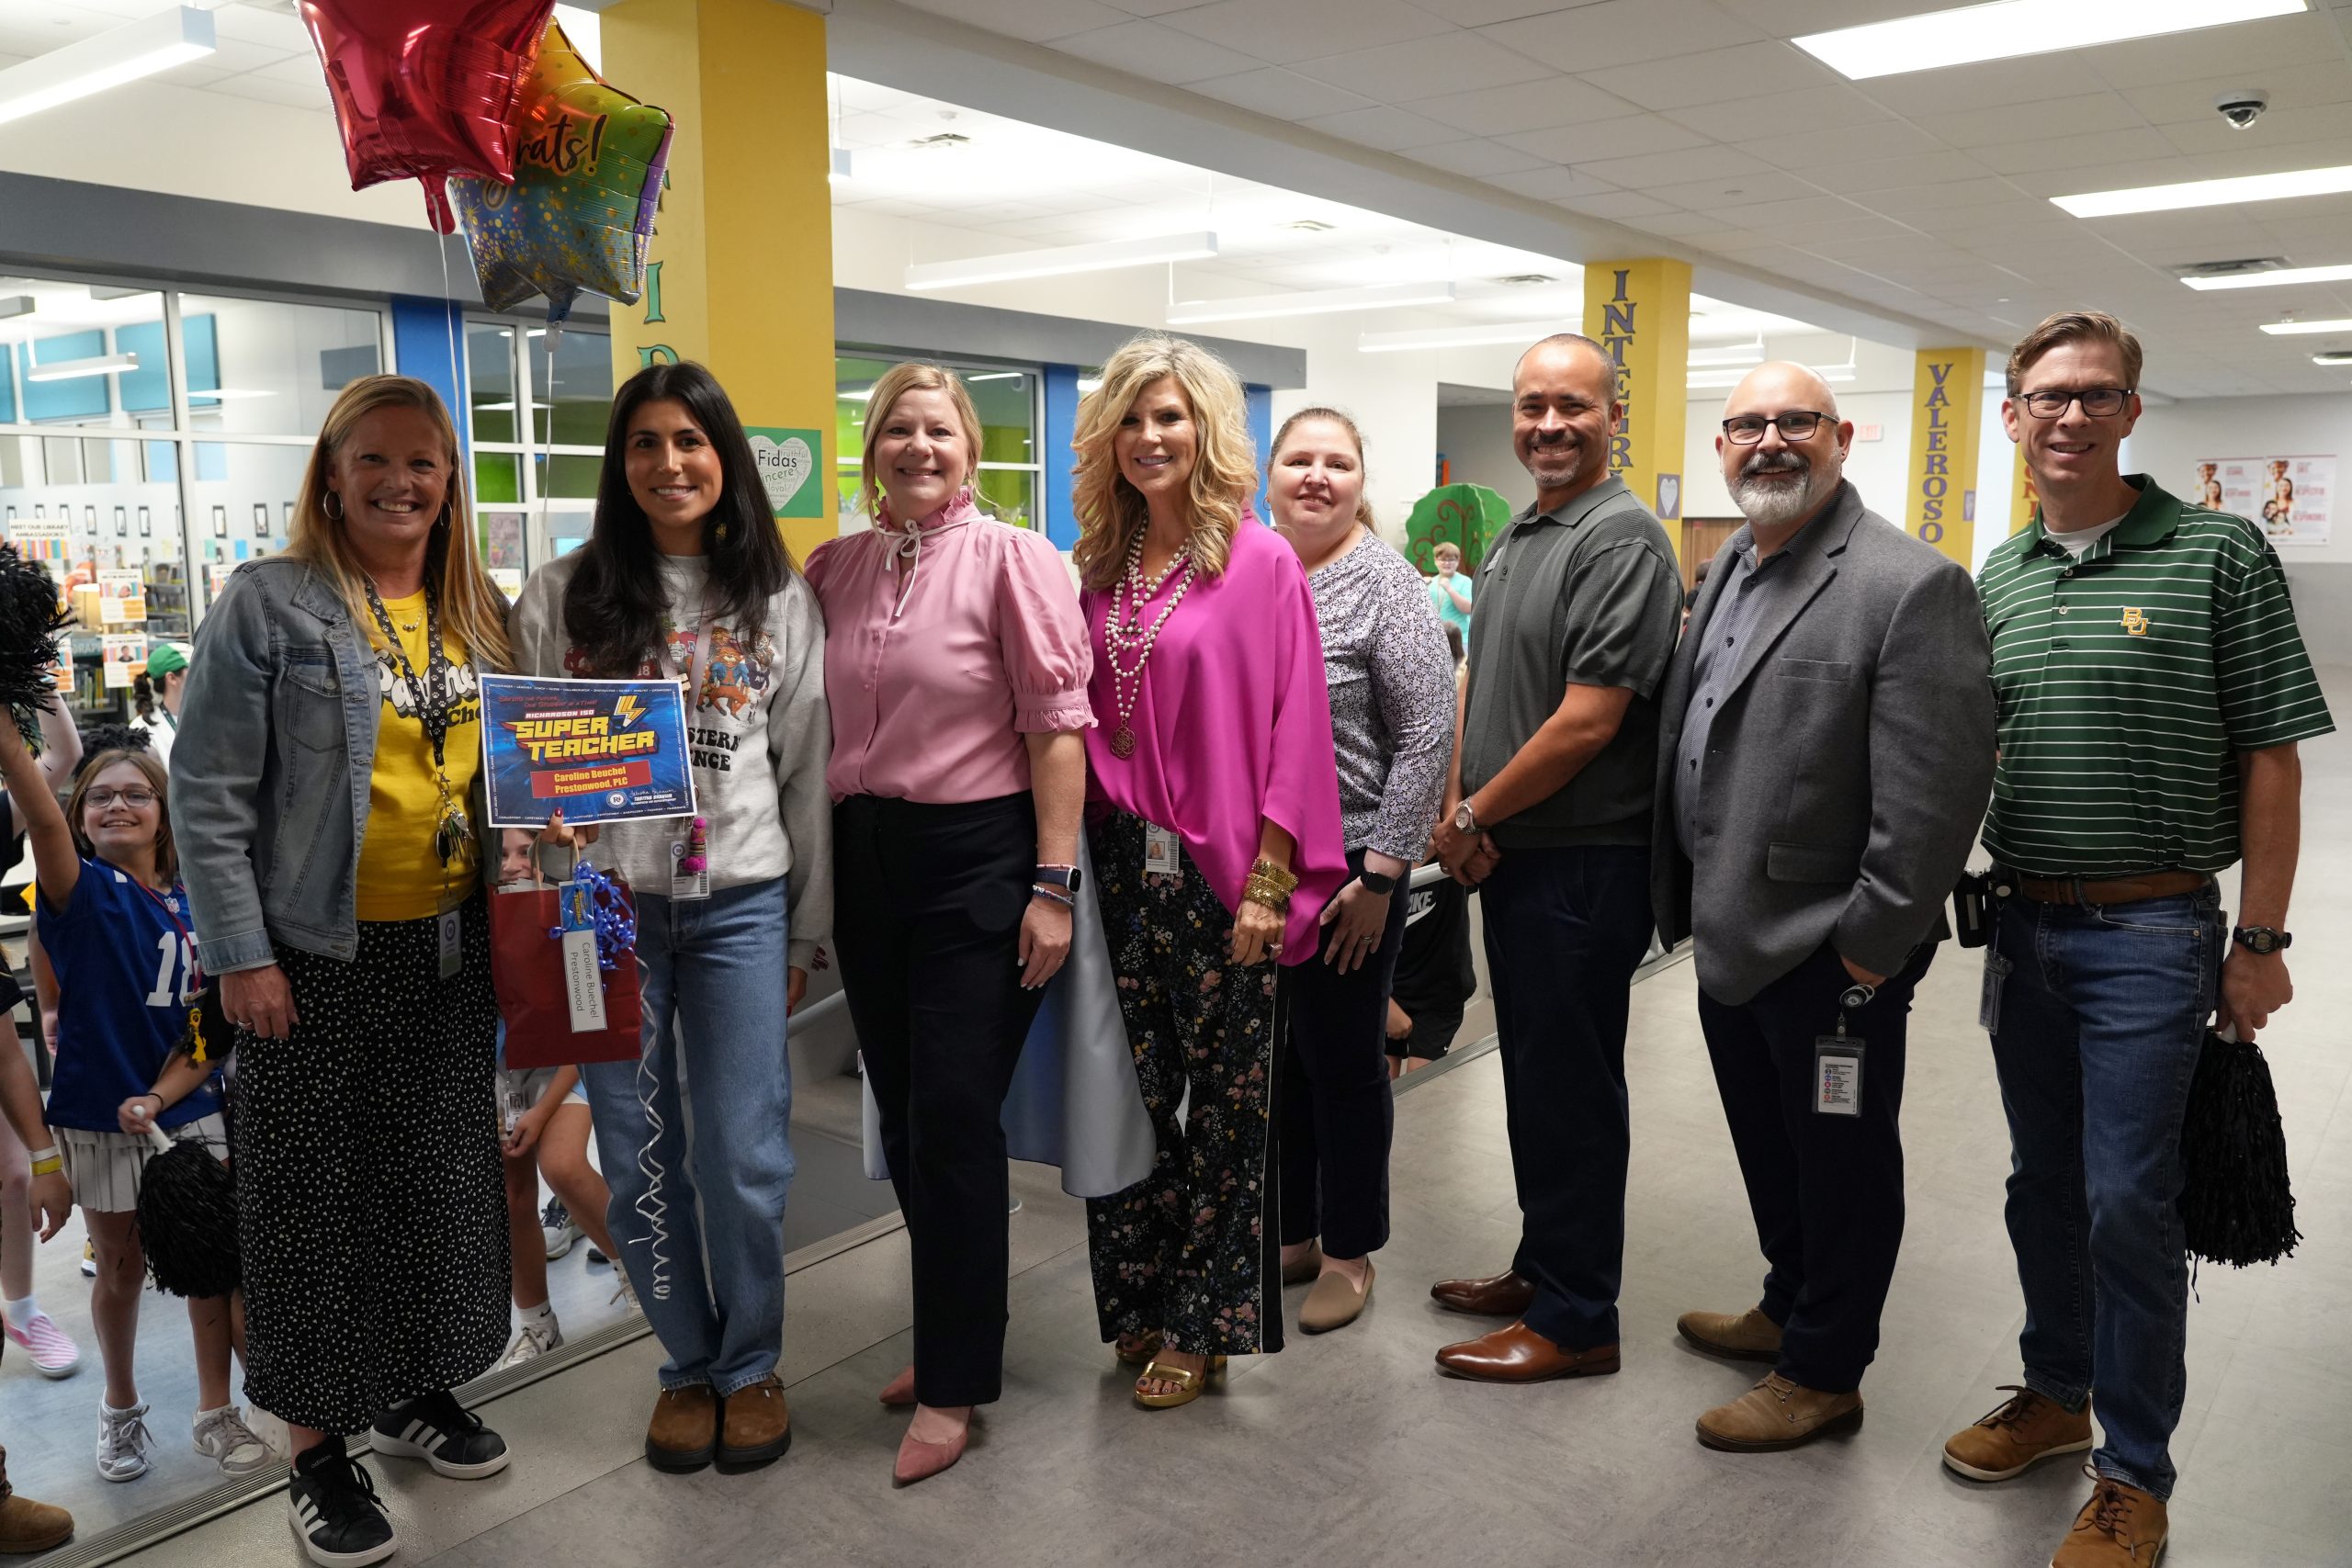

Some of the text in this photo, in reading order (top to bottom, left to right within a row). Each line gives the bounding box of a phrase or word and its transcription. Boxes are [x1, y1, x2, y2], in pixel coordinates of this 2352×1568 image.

[758, 449, 797, 468] Fidas
[1918, 363, 1954, 544] VALEROSO
[762, 468, 794, 483] incere
[768, 482, 786, 492] loyal
[2120, 606, 2148, 635] BU
[637, 665, 650, 676] 18
[447, 705, 481, 728] Ch
[525, 710, 578, 719] RICHARDSON
[504, 716, 609, 739] SUPER
[520, 730, 655, 761] TEACHER
[690, 750, 730, 772] NCE
[554, 766, 627, 783] Caroline Beuchel
[555, 777, 628, 794] Prestonwood, PLC
[571, 952, 583, 1011] Prestonwood
[582, 942, 599, 1018] Caroline Buechel
[311, 1454, 333, 1469] adidas
